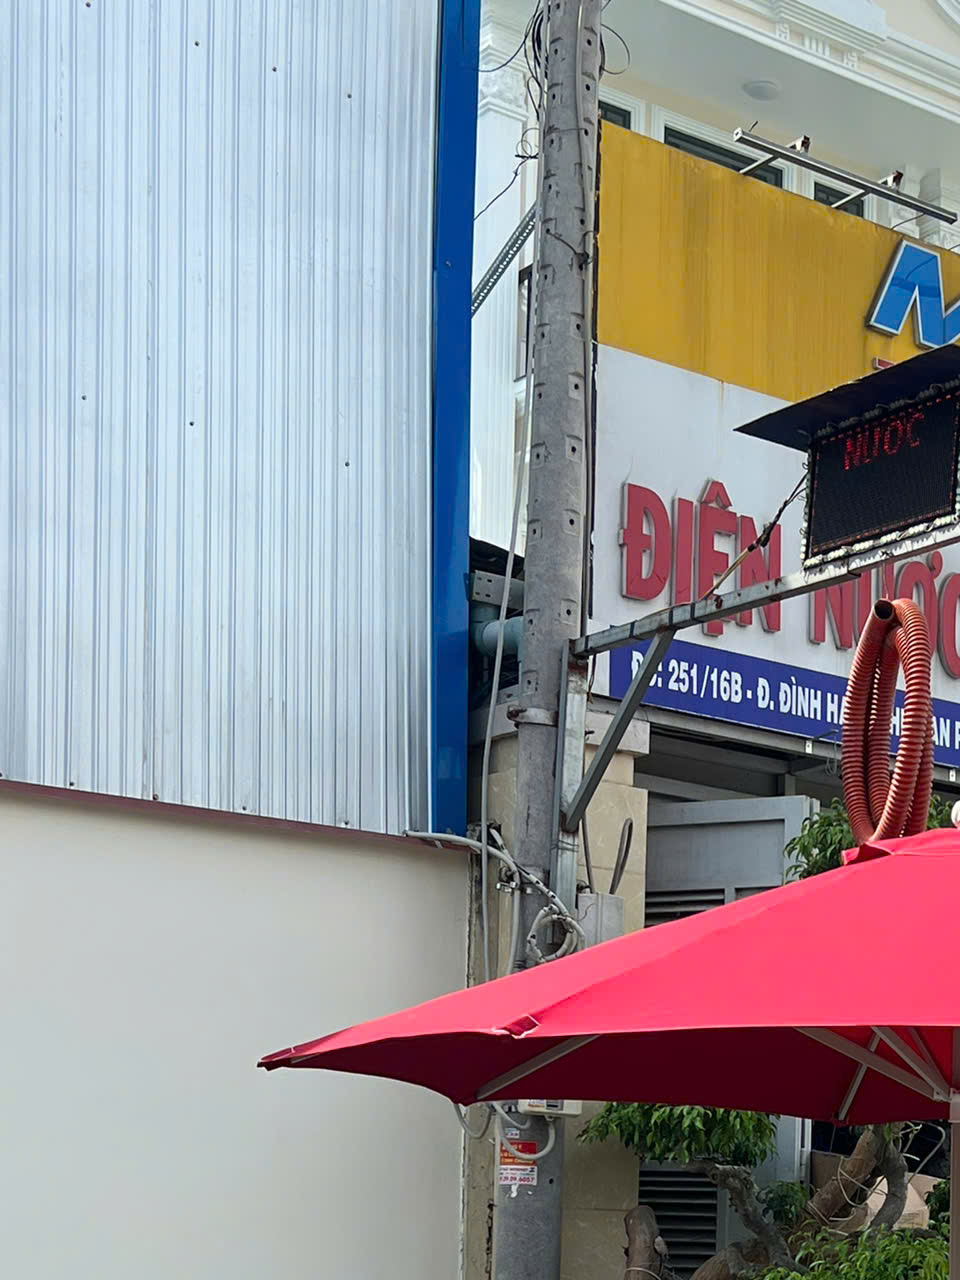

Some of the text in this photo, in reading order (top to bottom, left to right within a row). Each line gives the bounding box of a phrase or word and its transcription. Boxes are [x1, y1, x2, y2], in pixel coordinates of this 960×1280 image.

[619, 479, 781, 636] ĐIỆN
[668, 659, 742, 703] 251/16B
[757, 677, 774, 711] Đ.
[779, 676, 821, 720] ĐÌNH
